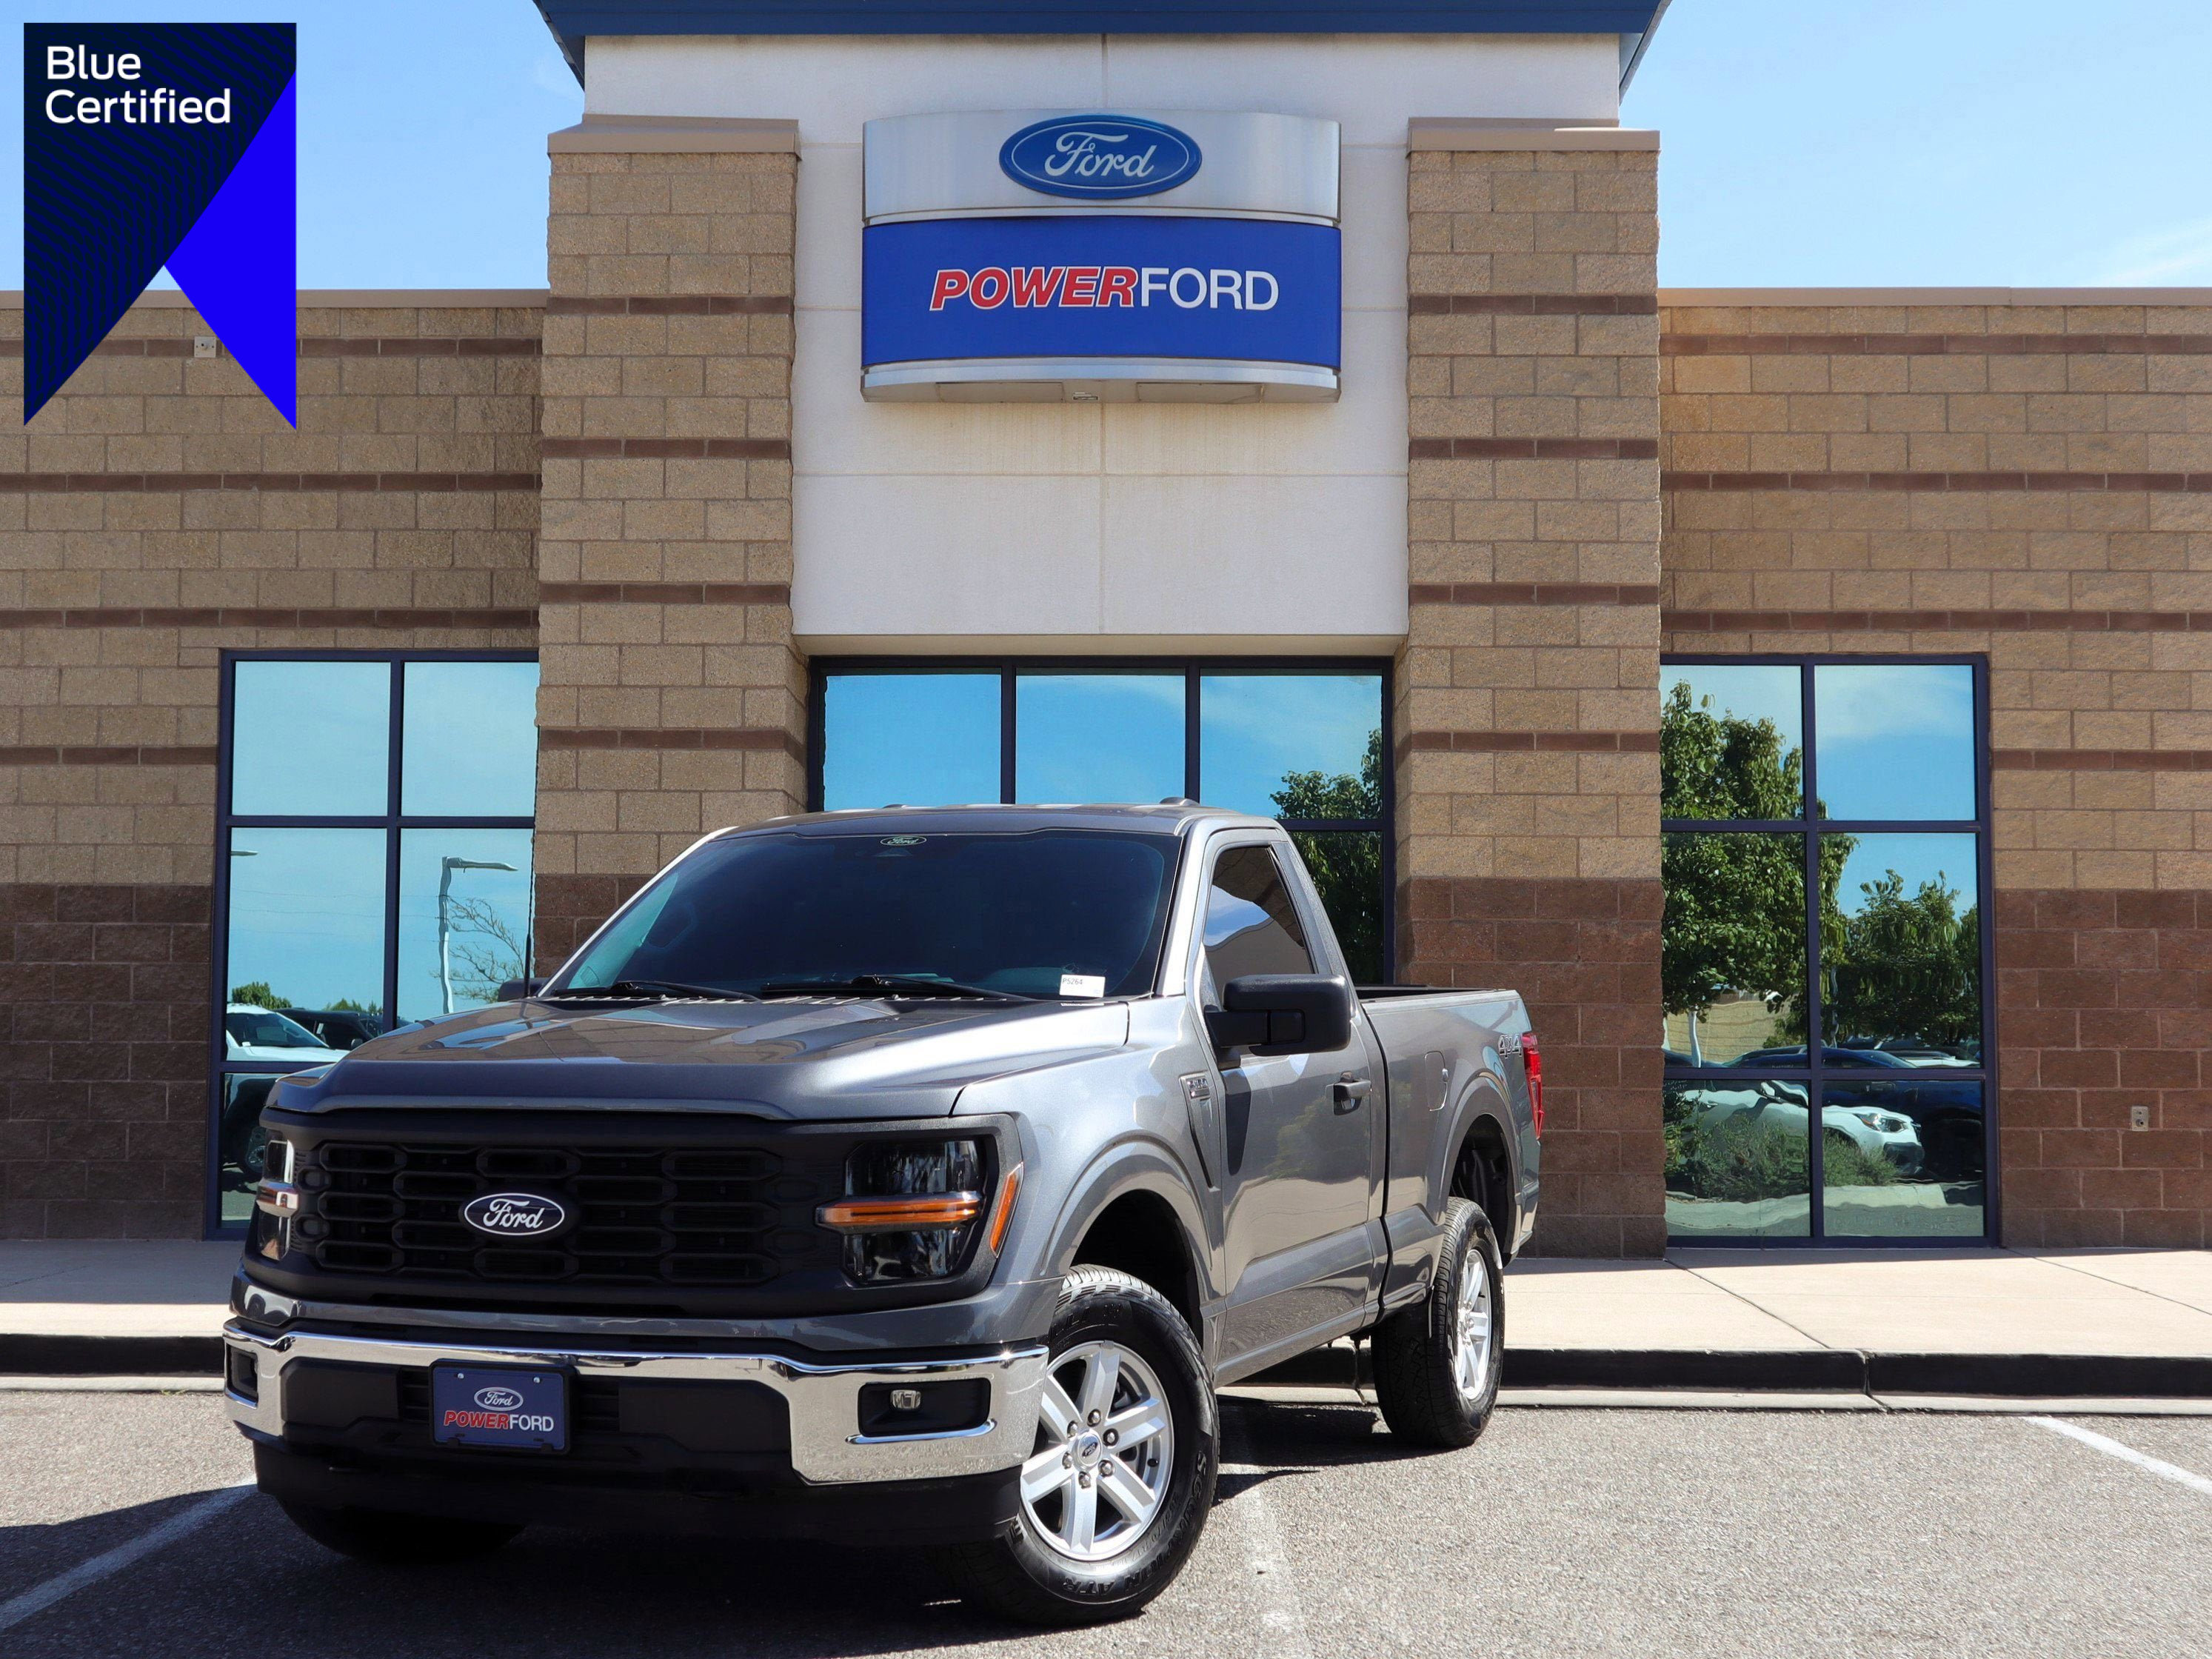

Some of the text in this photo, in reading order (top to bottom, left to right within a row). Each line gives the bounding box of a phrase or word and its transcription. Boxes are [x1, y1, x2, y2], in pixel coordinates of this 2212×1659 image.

[1043, 130, 1157, 178] Ford
[887, 836, 919, 844] Ford
[1062, 977, 1084, 985] P5264
[483, 1198, 544, 1229] Ford
[484, 1390, 512, 1406] Ford
